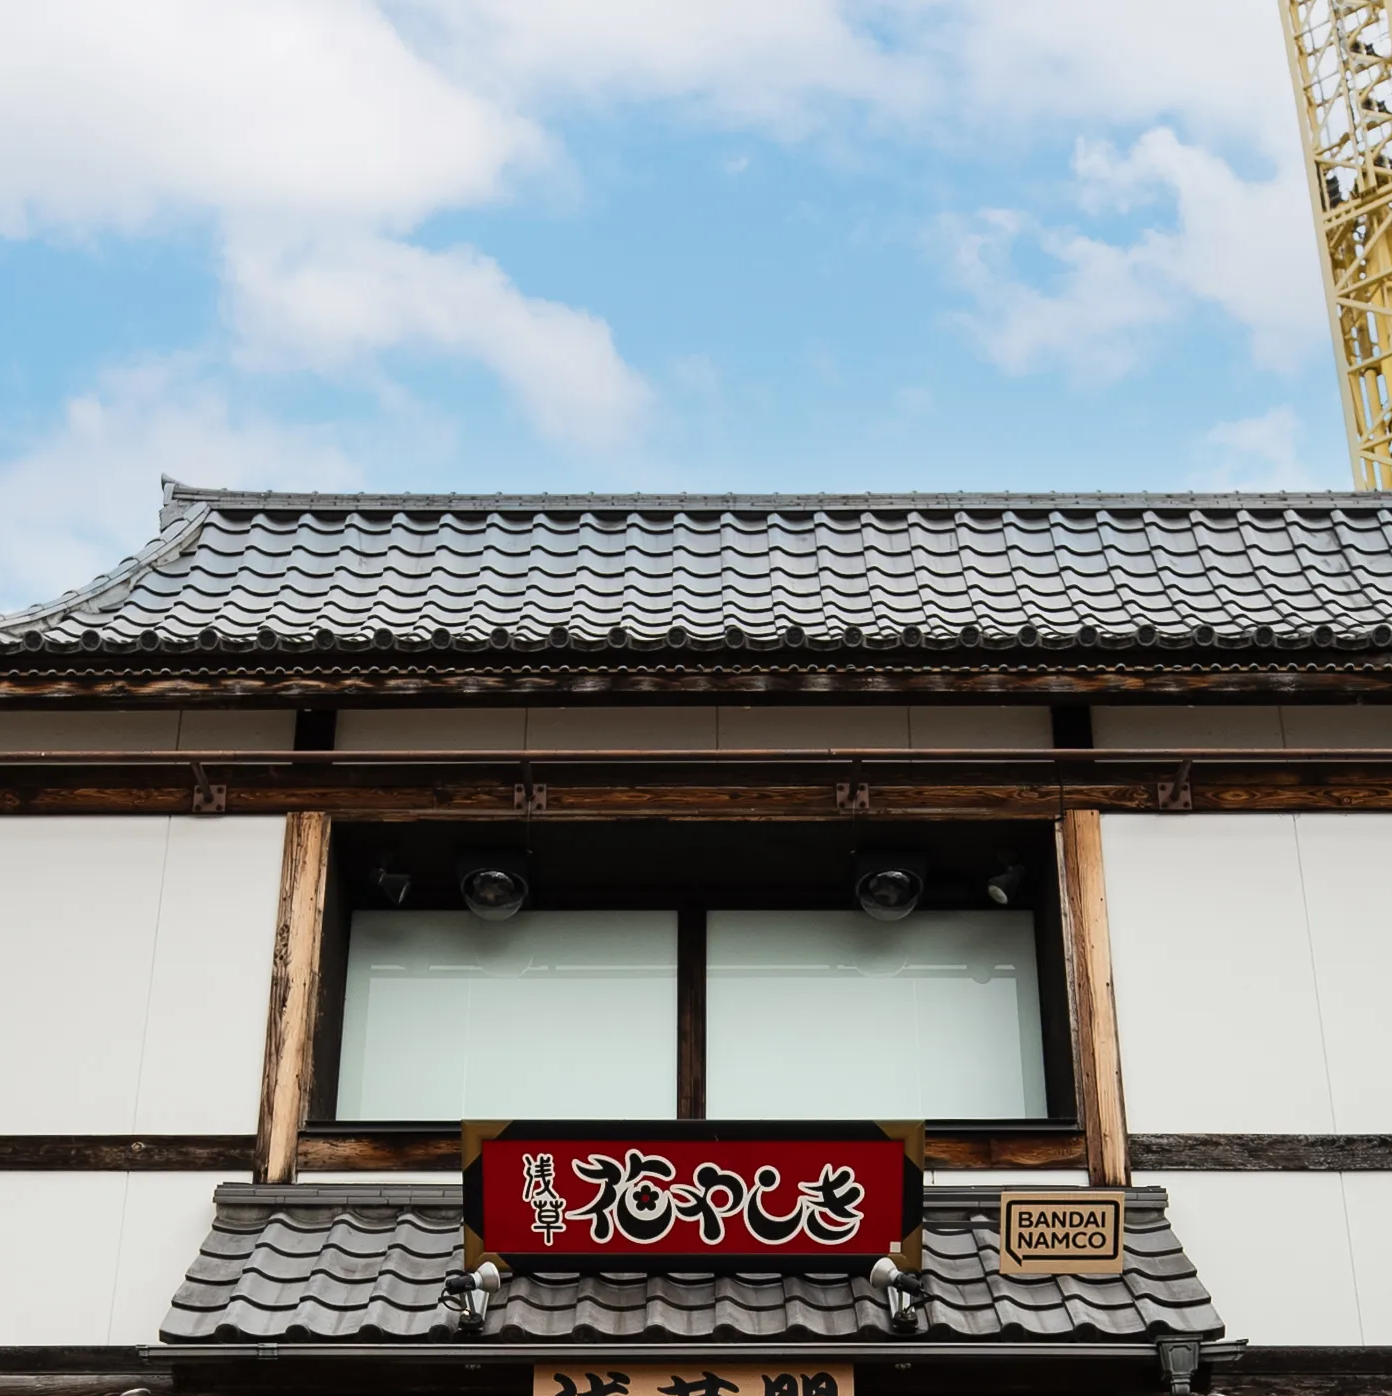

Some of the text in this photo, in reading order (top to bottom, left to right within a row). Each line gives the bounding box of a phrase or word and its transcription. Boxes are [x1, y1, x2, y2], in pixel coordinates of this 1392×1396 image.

[522, 1153, 566, 1246] 浅草
[565, 1148, 865, 1245] 花やしき
[1017, 1210, 1107, 1229] BANDAI
[1017, 1230, 1107, 1250] NAMCO
